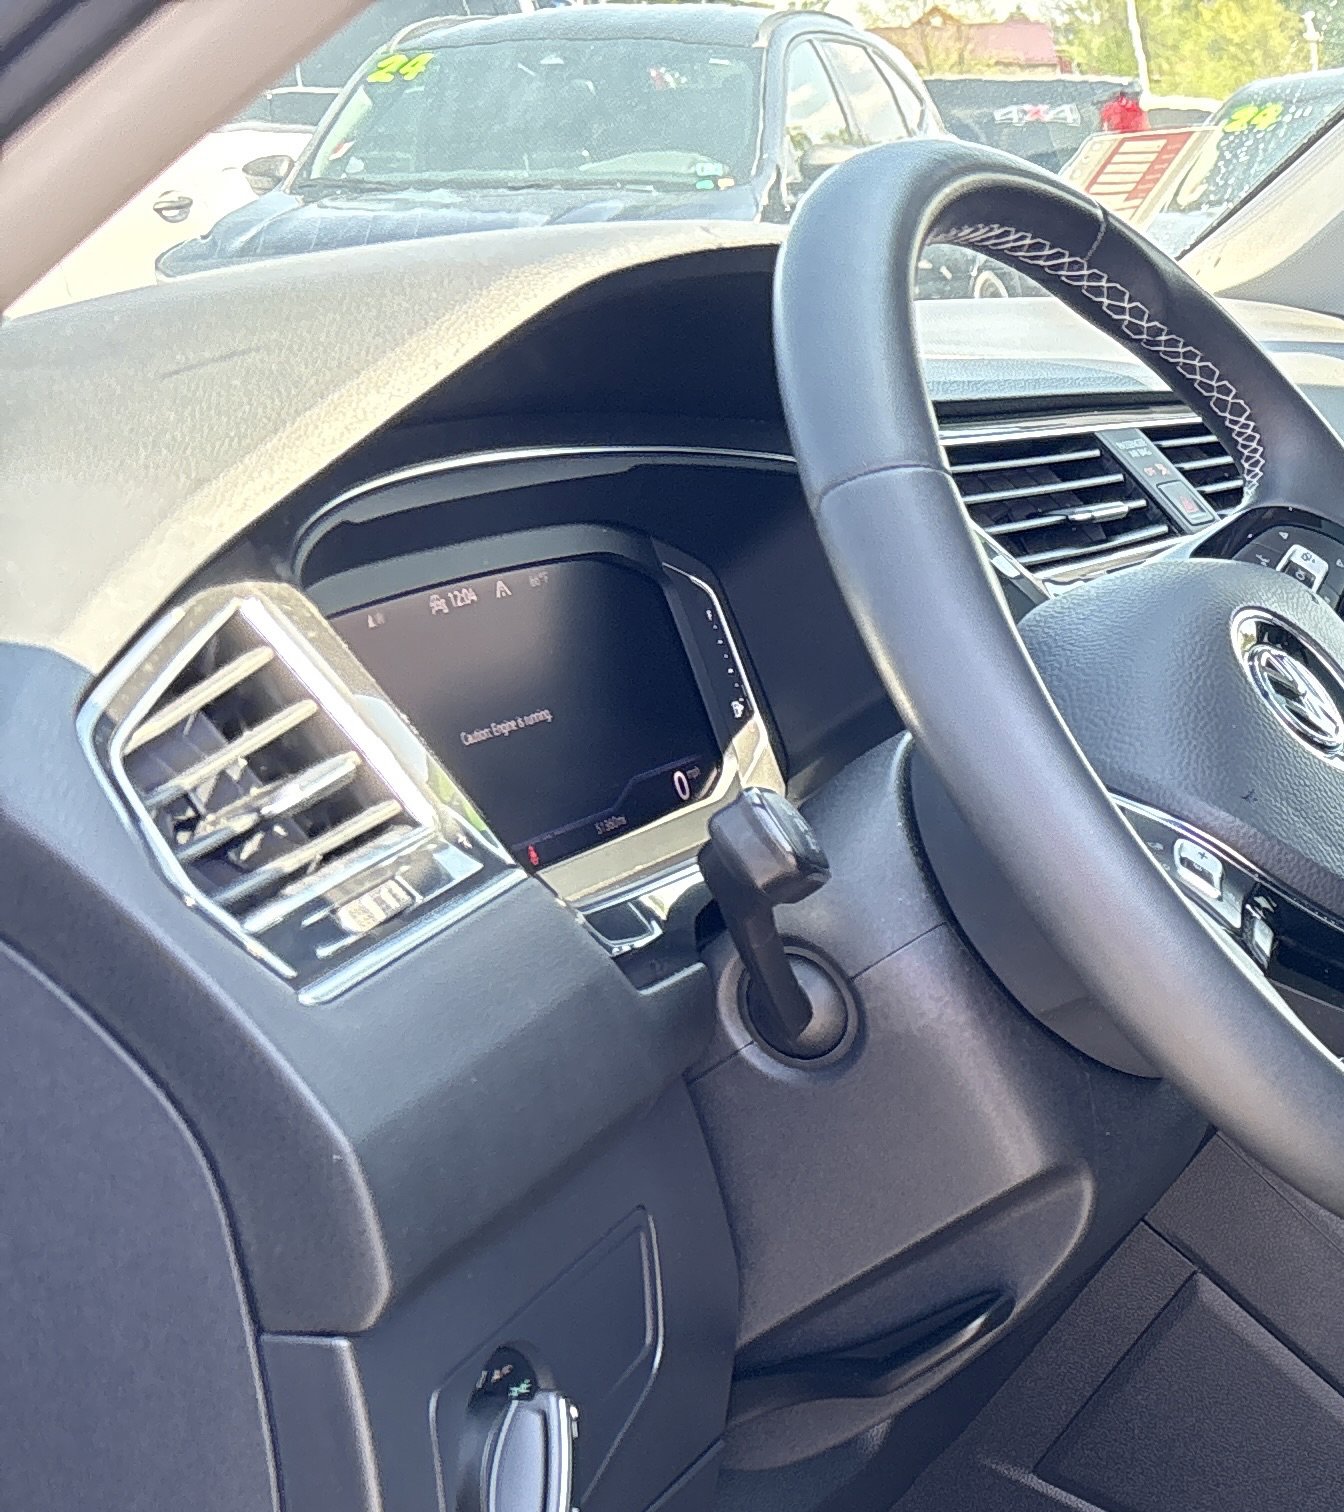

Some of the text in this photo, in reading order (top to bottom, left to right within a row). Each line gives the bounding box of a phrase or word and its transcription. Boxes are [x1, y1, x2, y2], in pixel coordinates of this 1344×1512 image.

[367, 53, 434, 82] 24
[490, 720, 518, 737] Engine
[673, 770, 690, 801] 0
